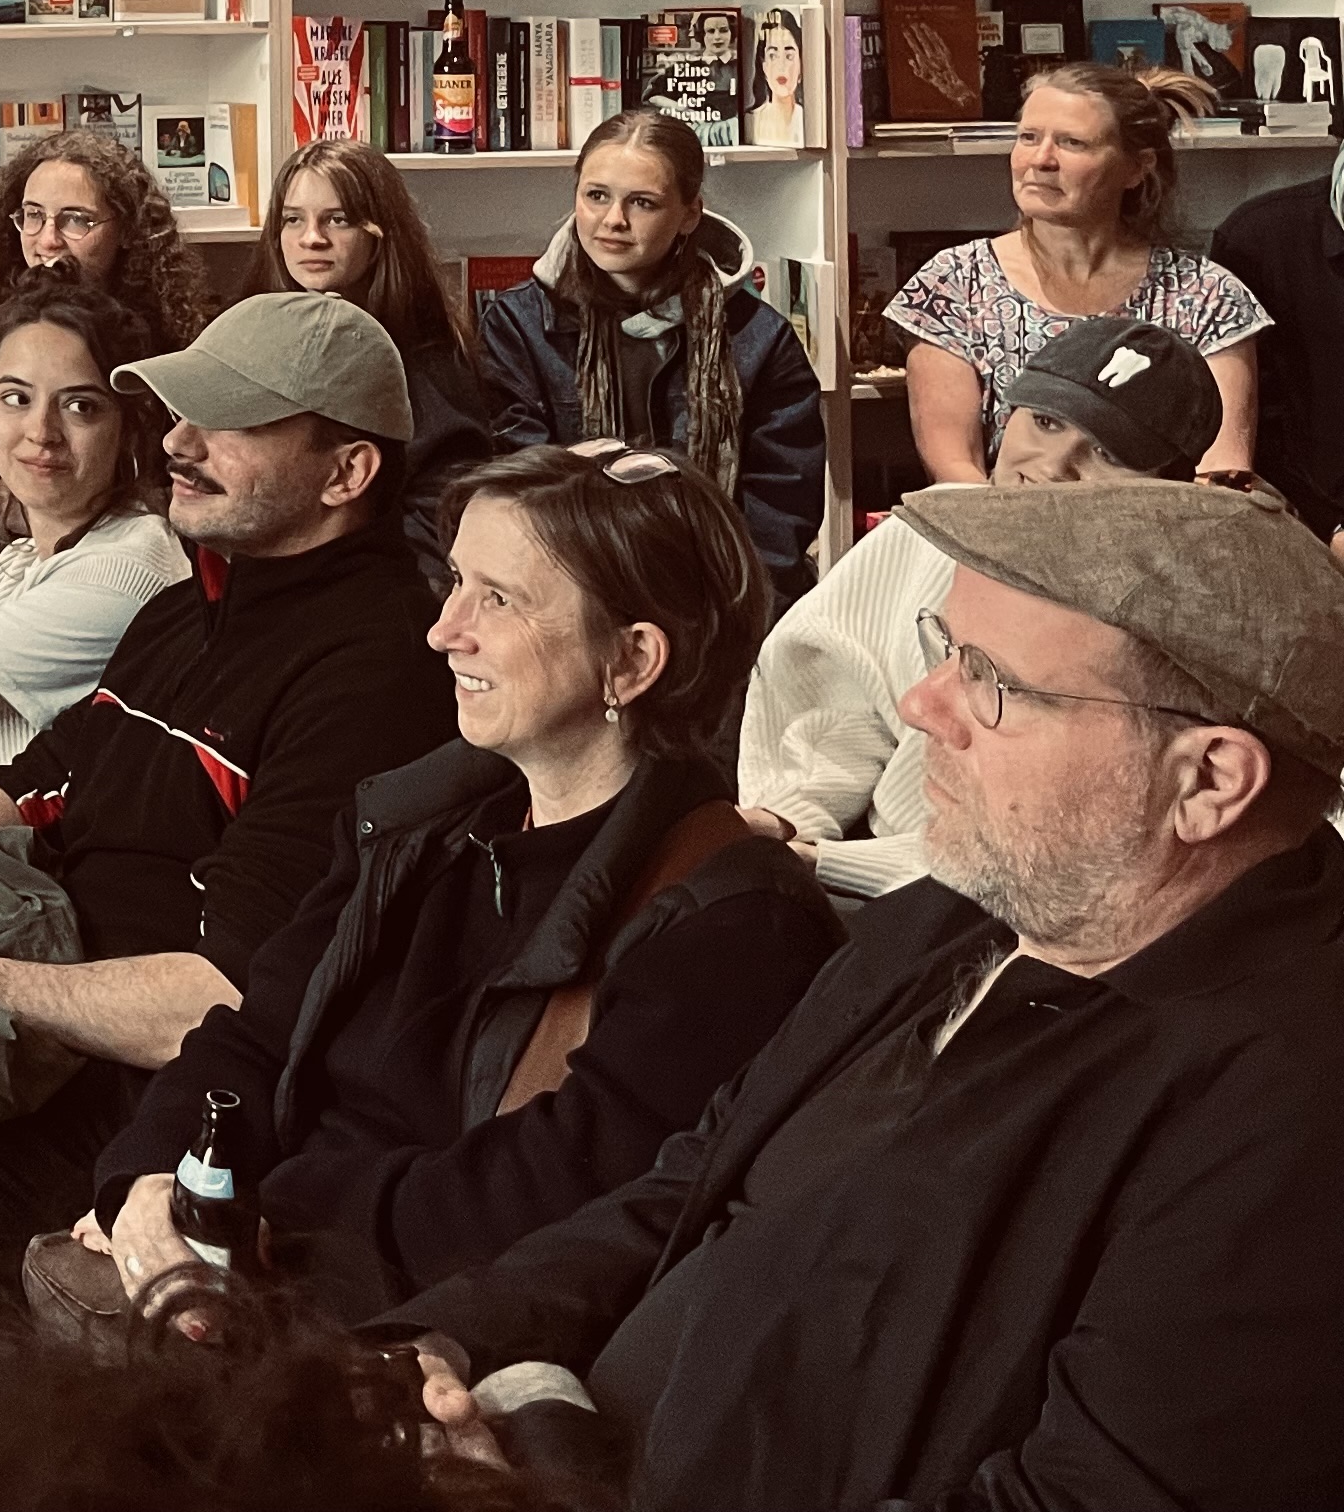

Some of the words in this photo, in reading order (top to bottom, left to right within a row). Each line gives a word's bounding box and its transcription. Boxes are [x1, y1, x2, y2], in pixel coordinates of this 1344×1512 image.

[534, 22, 543, 57] HANYA
[545, 22, 554, 87] YANAGIHARA
[673, 62, 711, 78] Eine
[666, 78, 716, 95] Frage
[312, 90, 351, 106] WISSEN
[677, 94, 706, 108] der
